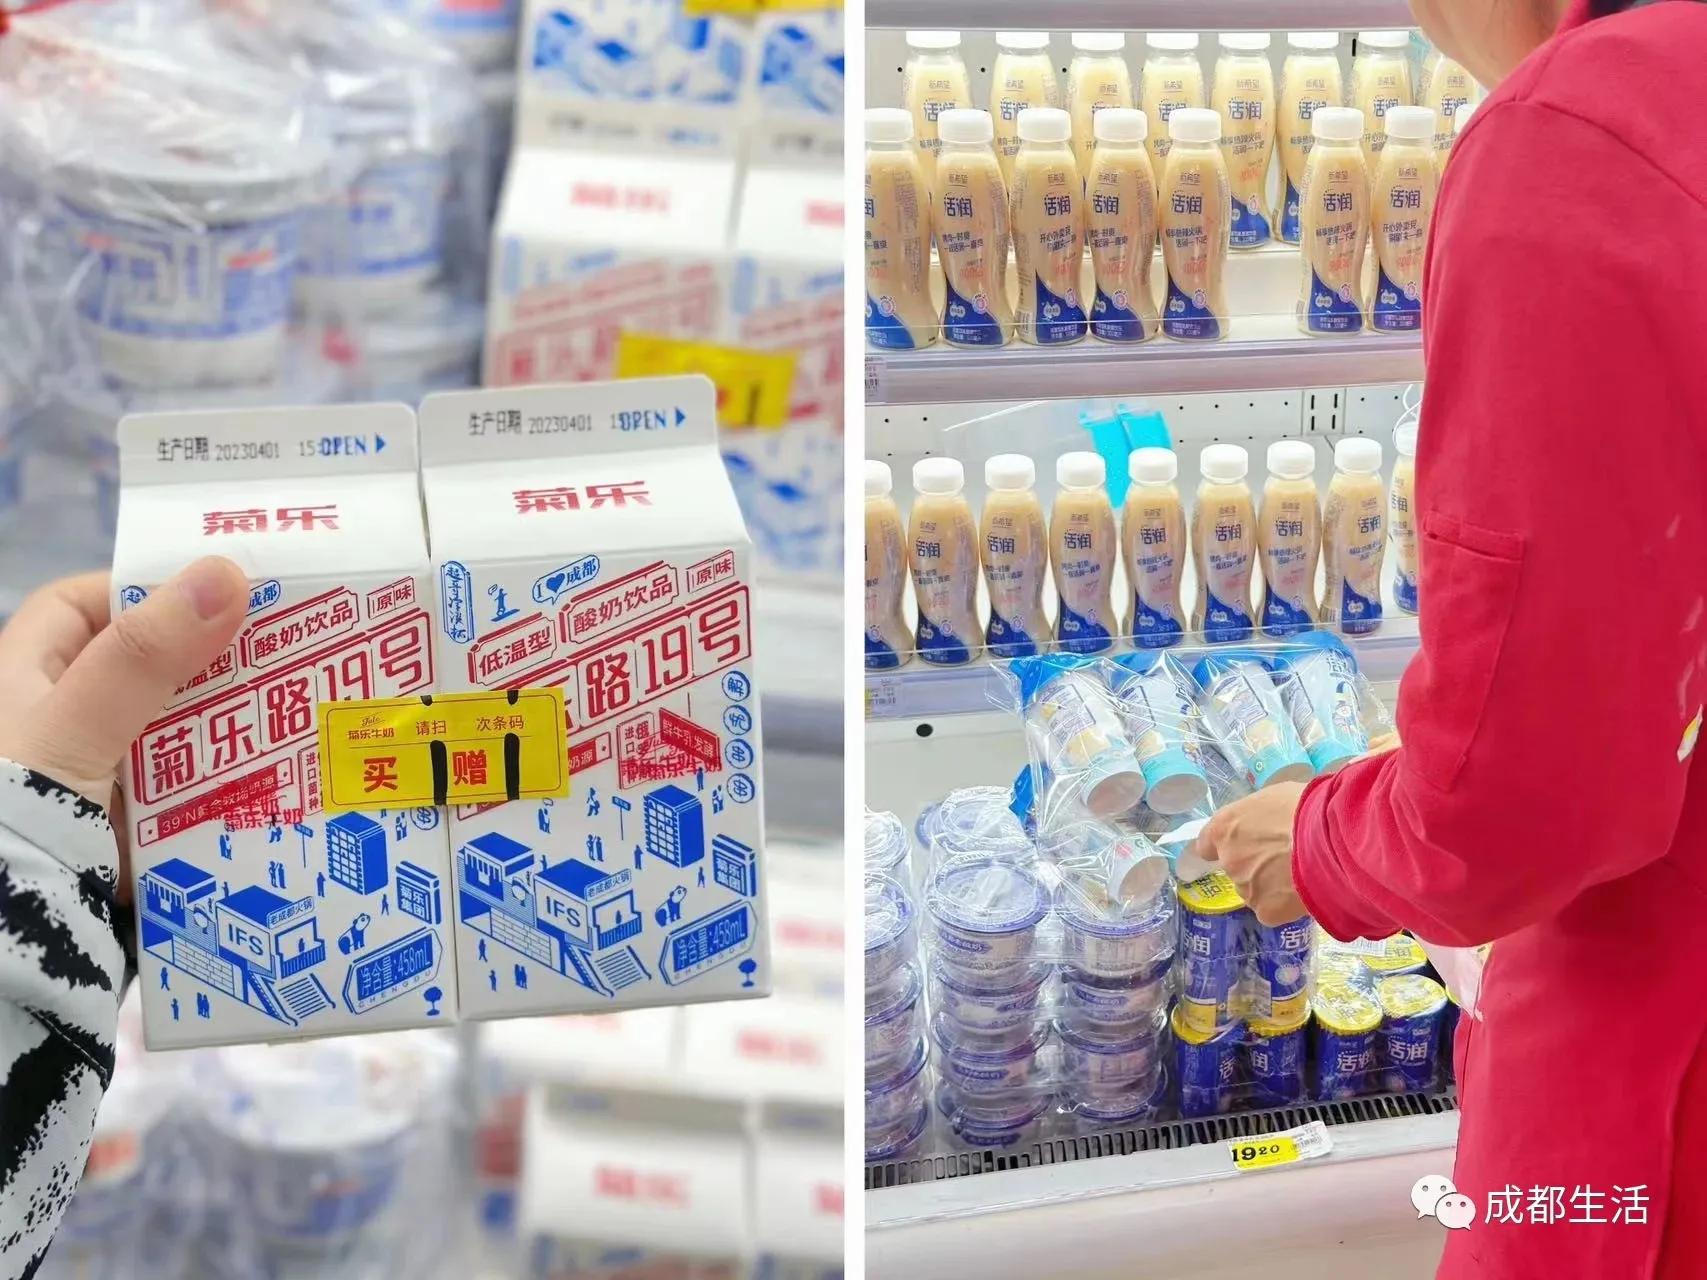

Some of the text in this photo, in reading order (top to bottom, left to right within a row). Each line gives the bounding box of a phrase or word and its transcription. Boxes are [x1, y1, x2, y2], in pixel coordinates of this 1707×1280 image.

[1229, 100, 1262, 120] 活润
[944, 196, 973, 217] 活润
[1043, 195, 1071, 216] 活润
[1092, 195, 1119, 216] 活润
[1171, 194, 1203, 214] 活润
[1323, 192, 1353, 212] 活润
[1390, 189, 1421, 209] 活润
[469, 411, 521, 435] 生产日期
[529, 415, 592, 433] 20230401
[619, 411, 667, 432] OPEN
[158, 437, 209, 461] 生产日期
[215, 443, 280, 460] 20230401
[321, 436, 367, 456] OPEN
[512, 481, 653, 514] 菊乐
[203, 505, 340, 535] 菊乐
[1275, 519, 1303, 536] 活润
[1064, 531, 1092, 549] 活润
[1140, 527, 1167, 545] 活润
[1215, 524, 1242, 541] 活润
[566, 560, 597, 583] 成都
[696, 558, 732, 585] 原味
[375, 584, 413, 611] 原味
[573, 574, 674, 634] 酸奶饮品
[254, 600, 353, 659] 酸奶饮品
[479, 626, 552, 677] 低温型
[151, 623, 422, 793] 菊乐路19号
[416, 715, 525, 736] 请扫 次条码
[306, 754, 318, 810] 进口菌种
[363, 749, 488, 793] 买 赠
[270, 898, 313, 924] 老成都火锅
[546, 896, 581, 928] IFS
[228, 923, 264, 956] IFS
[1388, 1042, 1428, 1061] 活润
